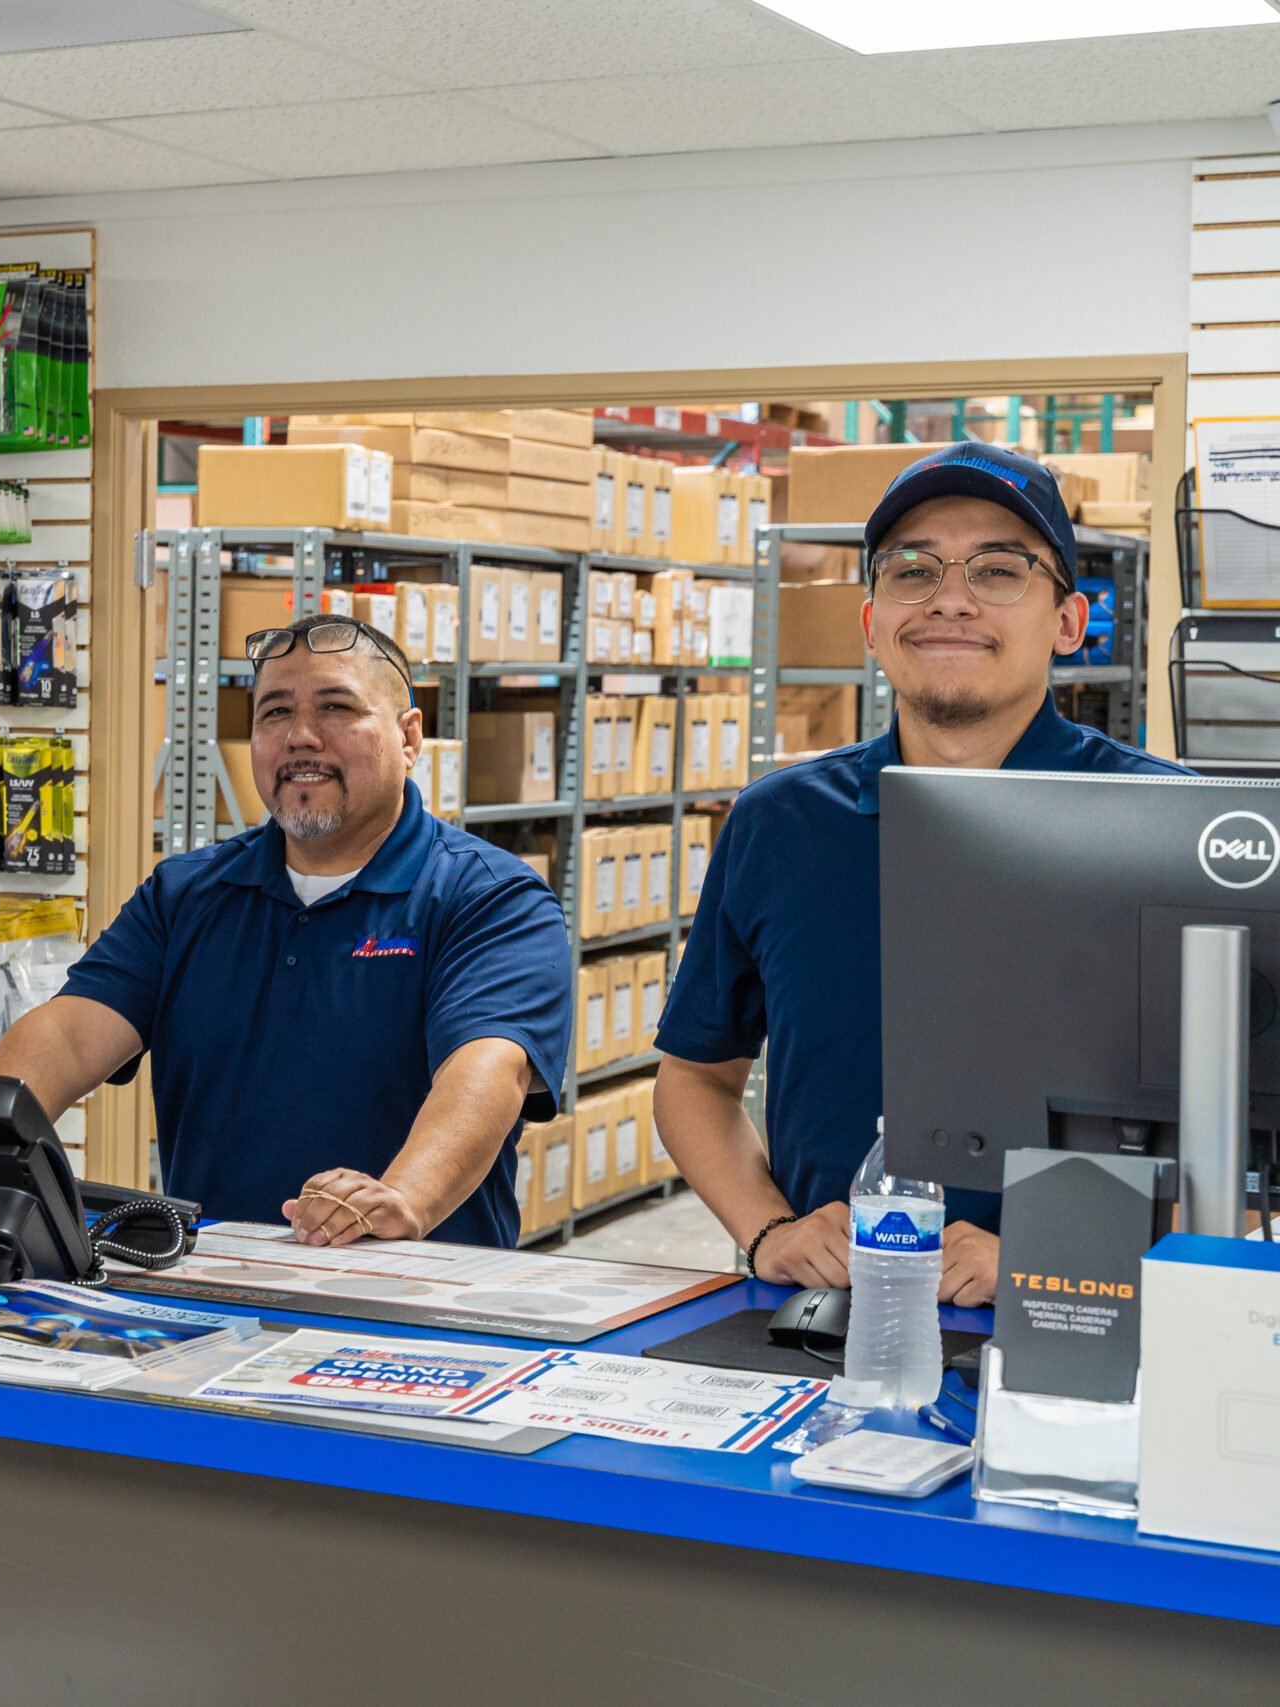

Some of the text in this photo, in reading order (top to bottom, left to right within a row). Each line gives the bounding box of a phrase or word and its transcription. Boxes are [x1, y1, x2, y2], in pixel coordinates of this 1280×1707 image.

[40, 678, 52, 692] 10
[9, 779, 36, 788] LS/UV
[26, 848, 40, 862] 75
[1209, 838, 1272, 861] DELL
[875, 1232, 918, 1245] WATER
[1011, 1272, 1134, 1299] TESLONG
[1022, 1300, 1118, 1318] INSPECTION CAMERAS
[1028, 1309, 1112, 1327] THERMAL CAMERAS
[1032, 1319, 1106, 1336] CAMERA PROBES
[316, 1367, 470, 1387] OPENING
[333, 1360, 465, 1377] GRAND
[306, 1376, 457, 1398] 09.27.23
[528, 1412, 574, 1425] GET
[580, 1418, 680, 1440] SOCIAL
